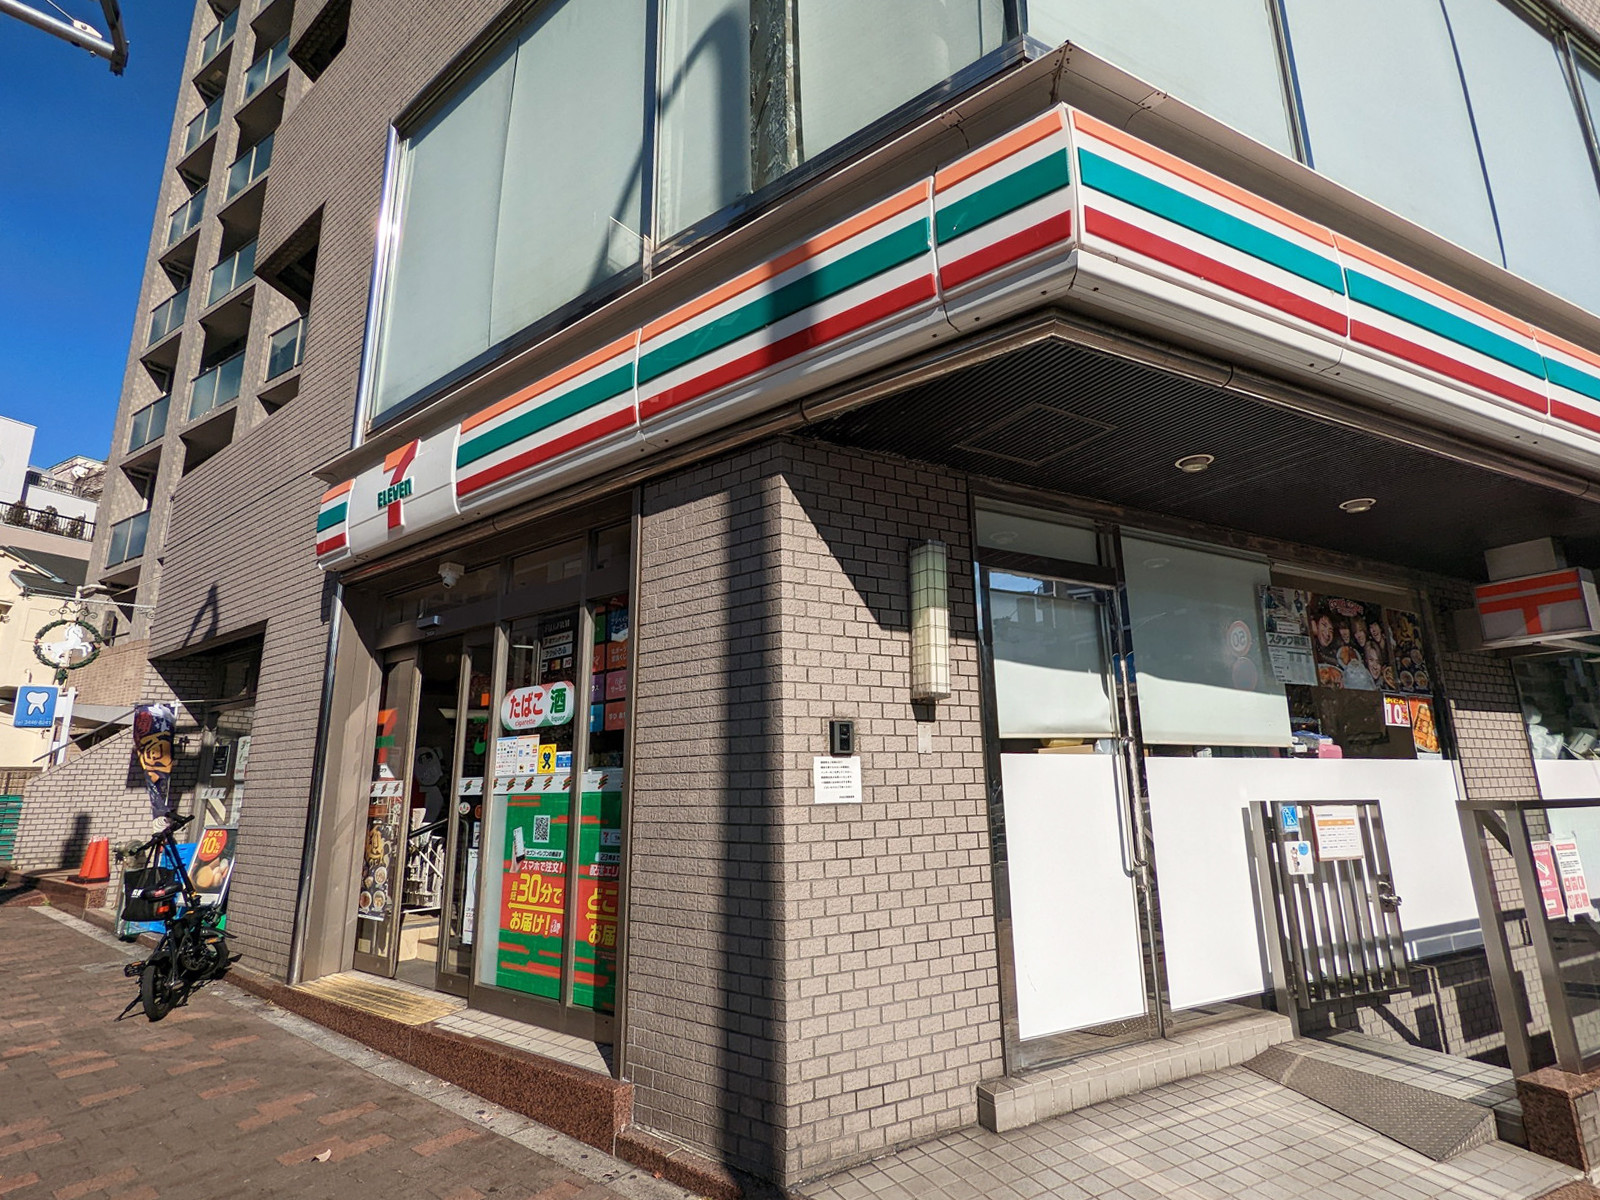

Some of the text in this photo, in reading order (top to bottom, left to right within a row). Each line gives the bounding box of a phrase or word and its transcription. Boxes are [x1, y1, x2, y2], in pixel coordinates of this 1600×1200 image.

[509, 687, 567, 719] たばこ 酒
[509, 911, 551, 936] お届け!
